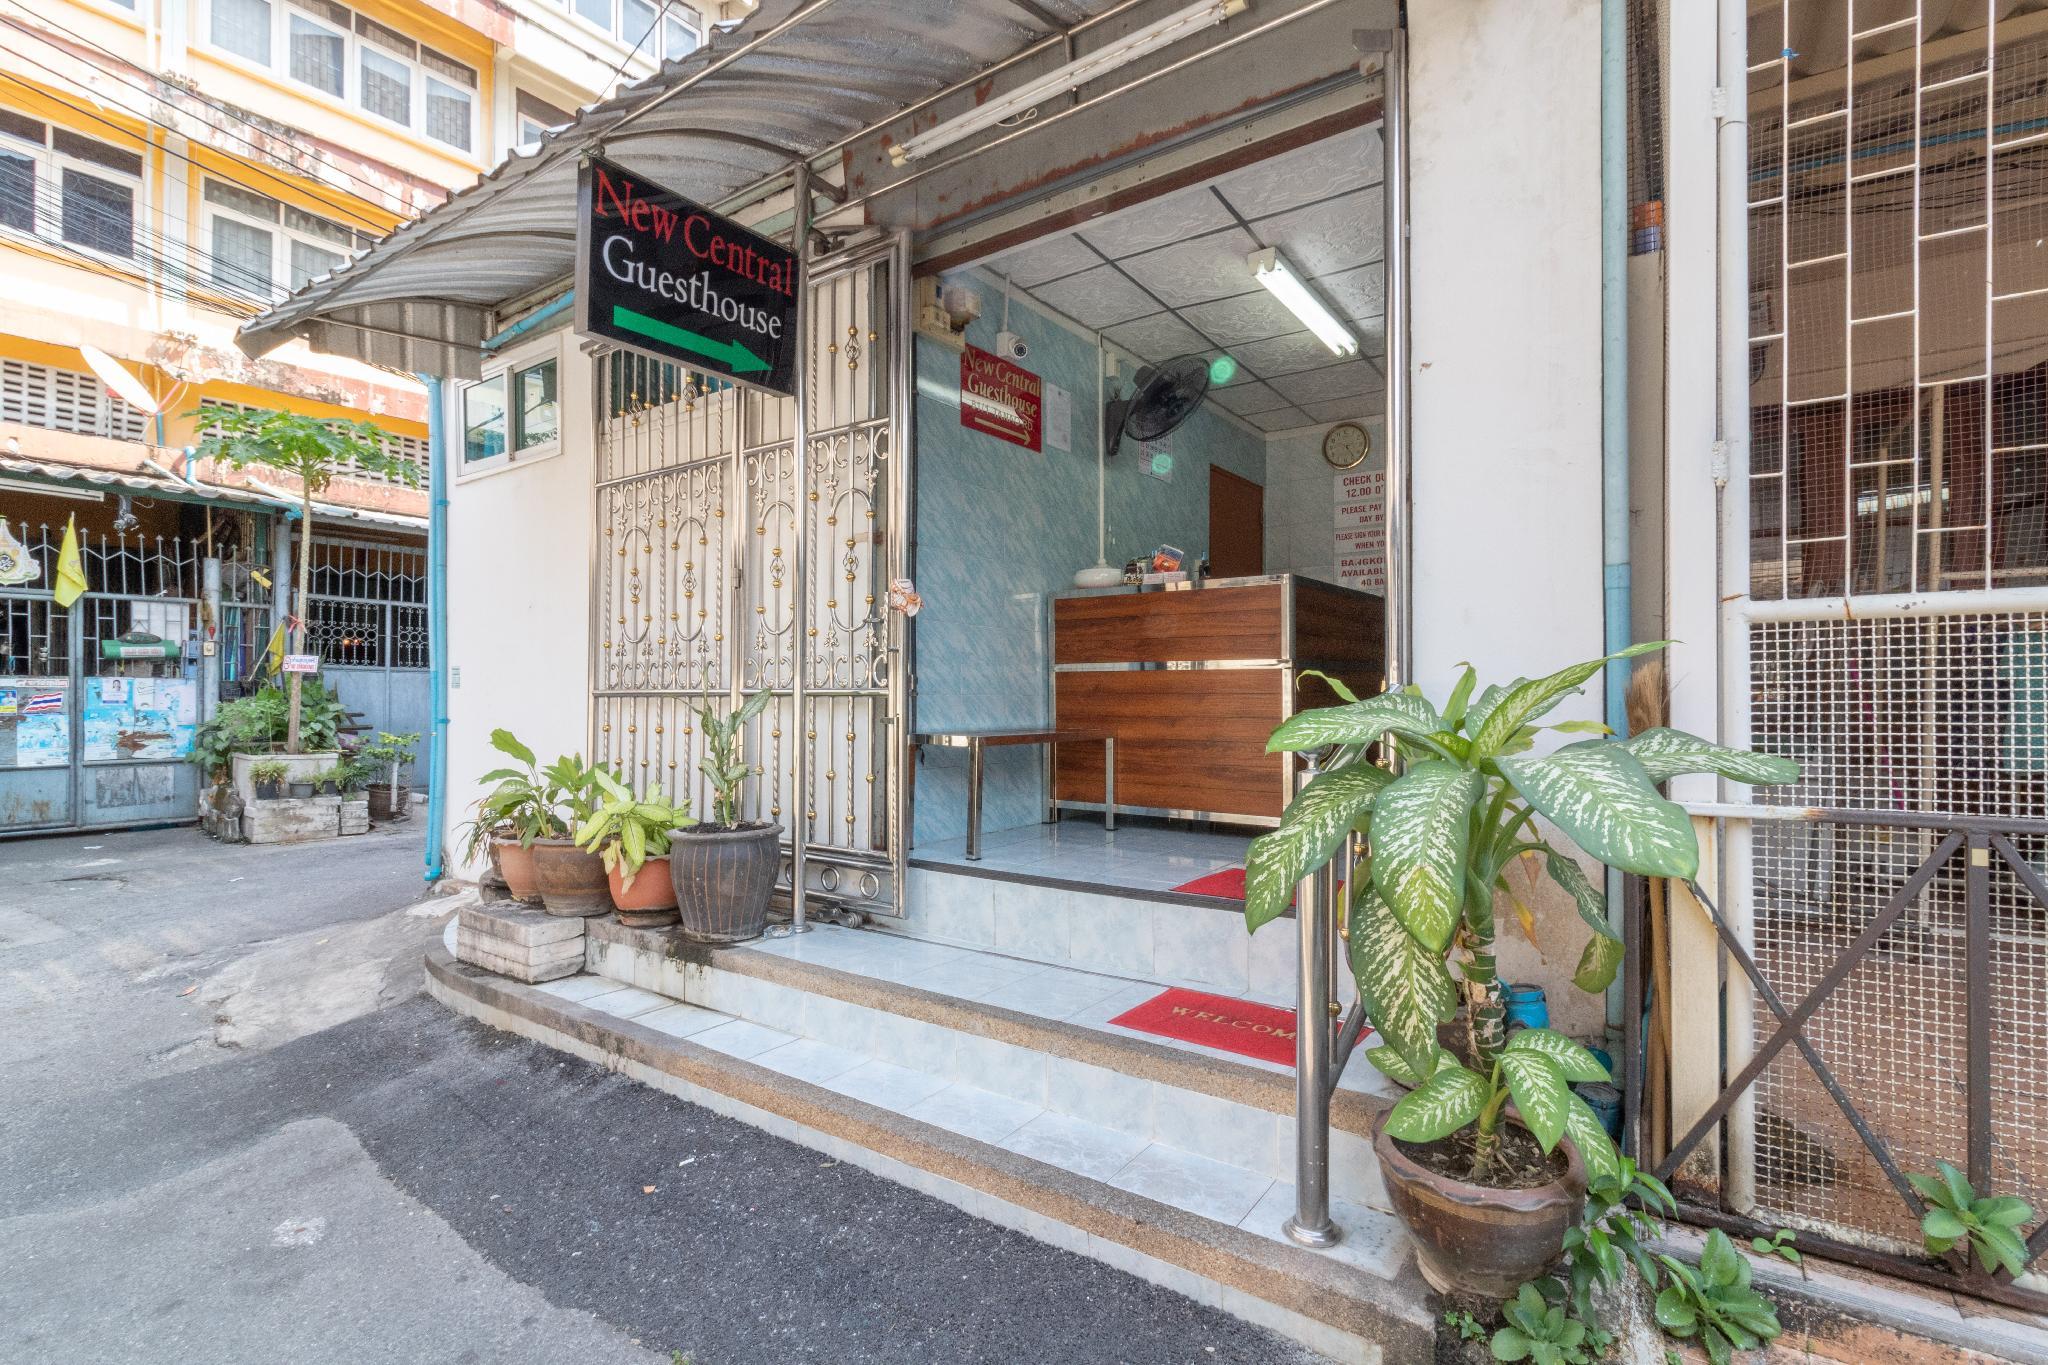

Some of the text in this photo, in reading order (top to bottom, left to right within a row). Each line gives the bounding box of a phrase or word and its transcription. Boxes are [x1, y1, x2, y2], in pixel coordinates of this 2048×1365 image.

[594, 167, 793, 296] New Central
[602, 234, 782, 339] Guesthouse
[964, 349, 1040, 397] New Central
[968, 373, 1038, 417] Guesthouse
[1343, 474, 1371, 487] CHECK
[1346, 486, 1371, 498] 12.00
[1341, 503, 1382, 515] PLEASE PAY
[1359, 514, 1384, 523] DAY BY
[1335, 532, 1353, 541] PLEASE
[1367, 529, 1381, 538] YOUR
[1355, 541, 1374, 549] WHEN
[1361, 578, 1372, 587] 40
